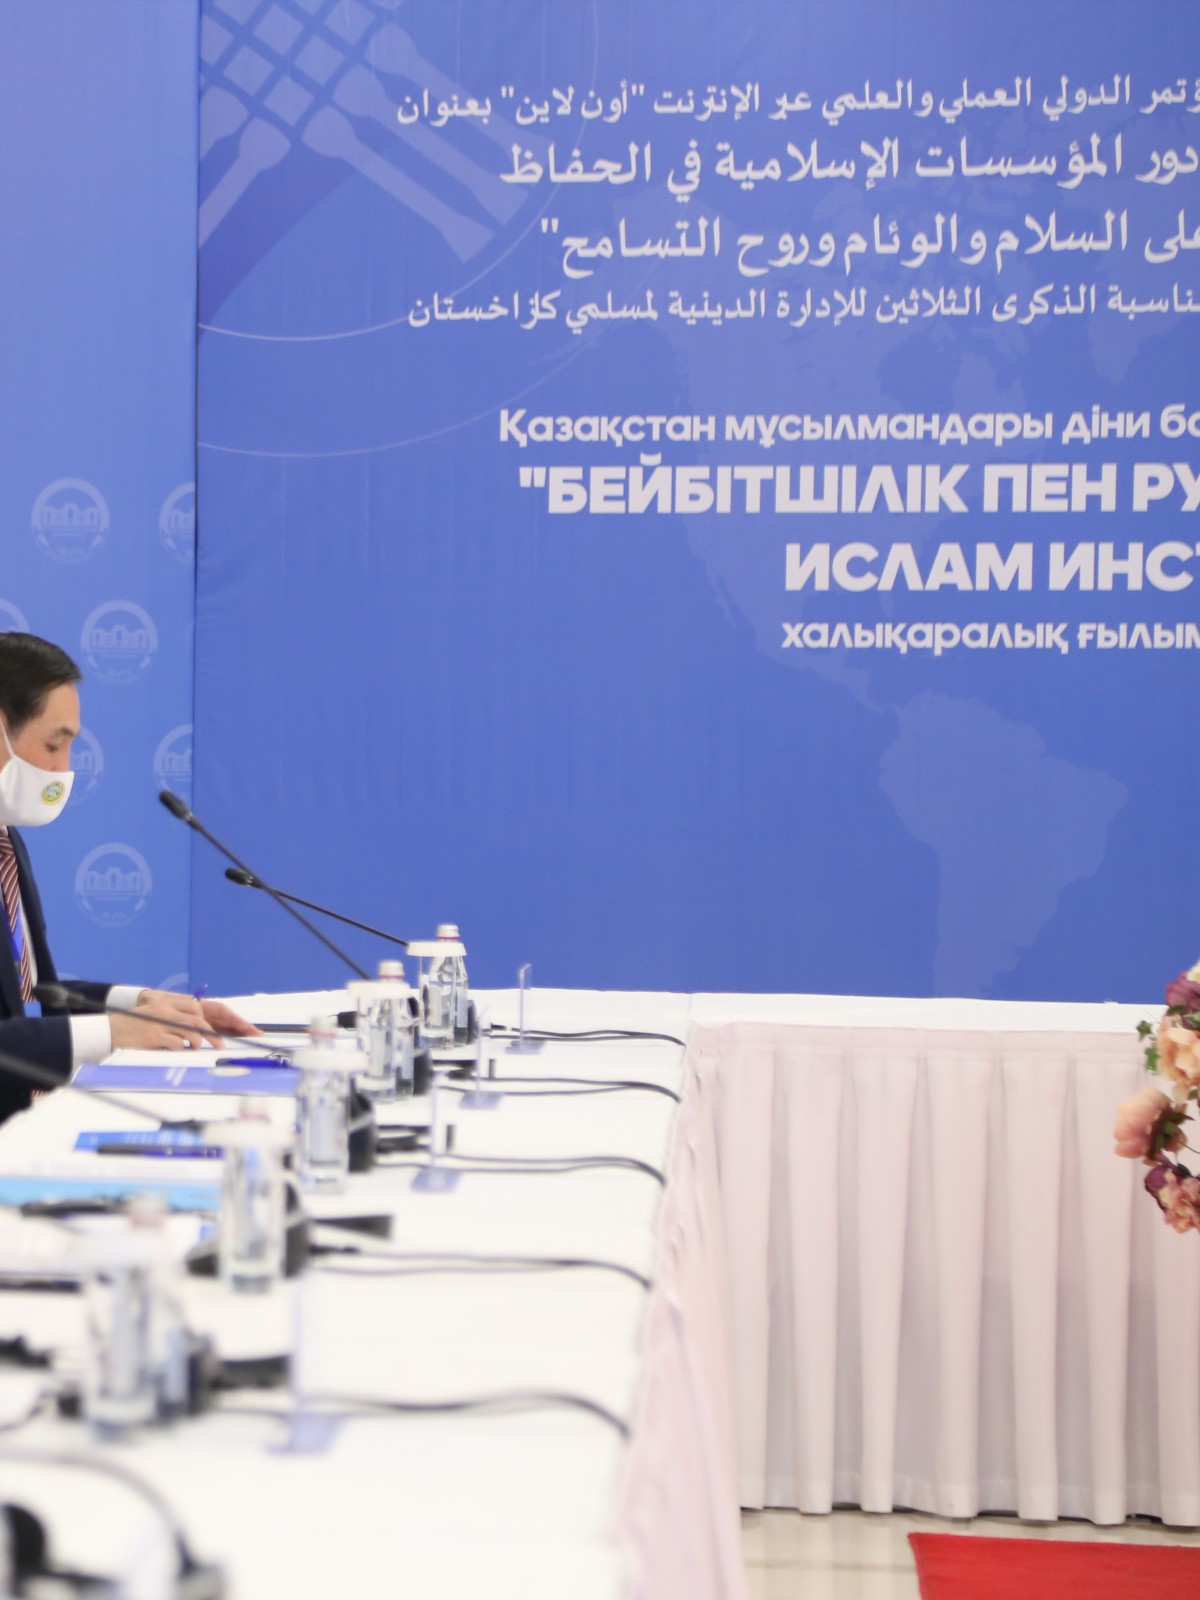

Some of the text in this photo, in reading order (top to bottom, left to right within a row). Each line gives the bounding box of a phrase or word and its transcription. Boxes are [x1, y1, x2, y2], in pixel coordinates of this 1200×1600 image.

[397, 88, 492, 127] بعنوان
[653, 82, 760, 122] الإنترنت
[769, 91, 812, 120] عبر
[938, 76, 1032, 124] العملي
[1042, 73, 1131, 122] الدولي
[499, 141, 652, 185] الحفاظ
[667, 139, 702, 203] في
[715, 137, 899, 190] الإسلامية
[915, 132, 1122, 189] المؤسسات
[995, 209, 1128, 274] السلام
[565, 289, 659, 335] لمسلمي
[668, 288, 766, 326] الدينية
[776, 286, 867, 327] للإدارة
[875, 285, 981, 324] الثلاثين
[992, 283, 1096, 325] الذكرى
[499, 408, 716, 448] Қазақстан
[725, 412, 1054, 448] мұсылмандары
[1061, 404, 1151, 445] діни
[518, 452, 969, 514] "БЕЙБІТШІЛІК
[983, 463, 1117, 513] ПЕН
[784, 540, 1200, 592] ИСЛАМ ИНС
[781, 622, 1070, 657] халықаралық
